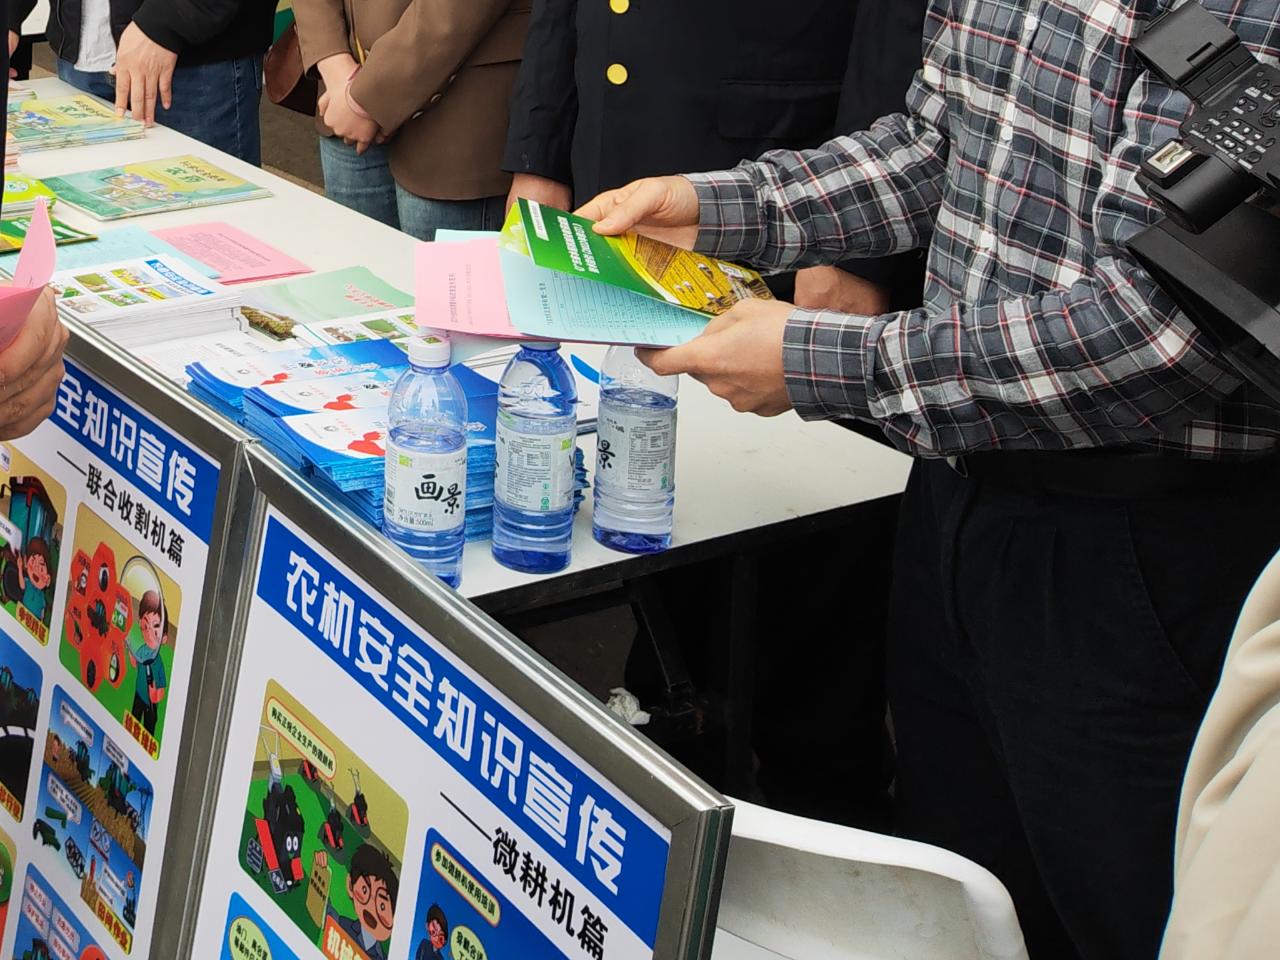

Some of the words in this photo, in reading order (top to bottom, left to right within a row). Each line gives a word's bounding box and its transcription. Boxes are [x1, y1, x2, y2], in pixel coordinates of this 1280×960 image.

[55, 372, 197, 517] 全知识宣传
[414, 474, 462, 515] 画景
[286, 549, 629, 896] 农机安全知识宣传
